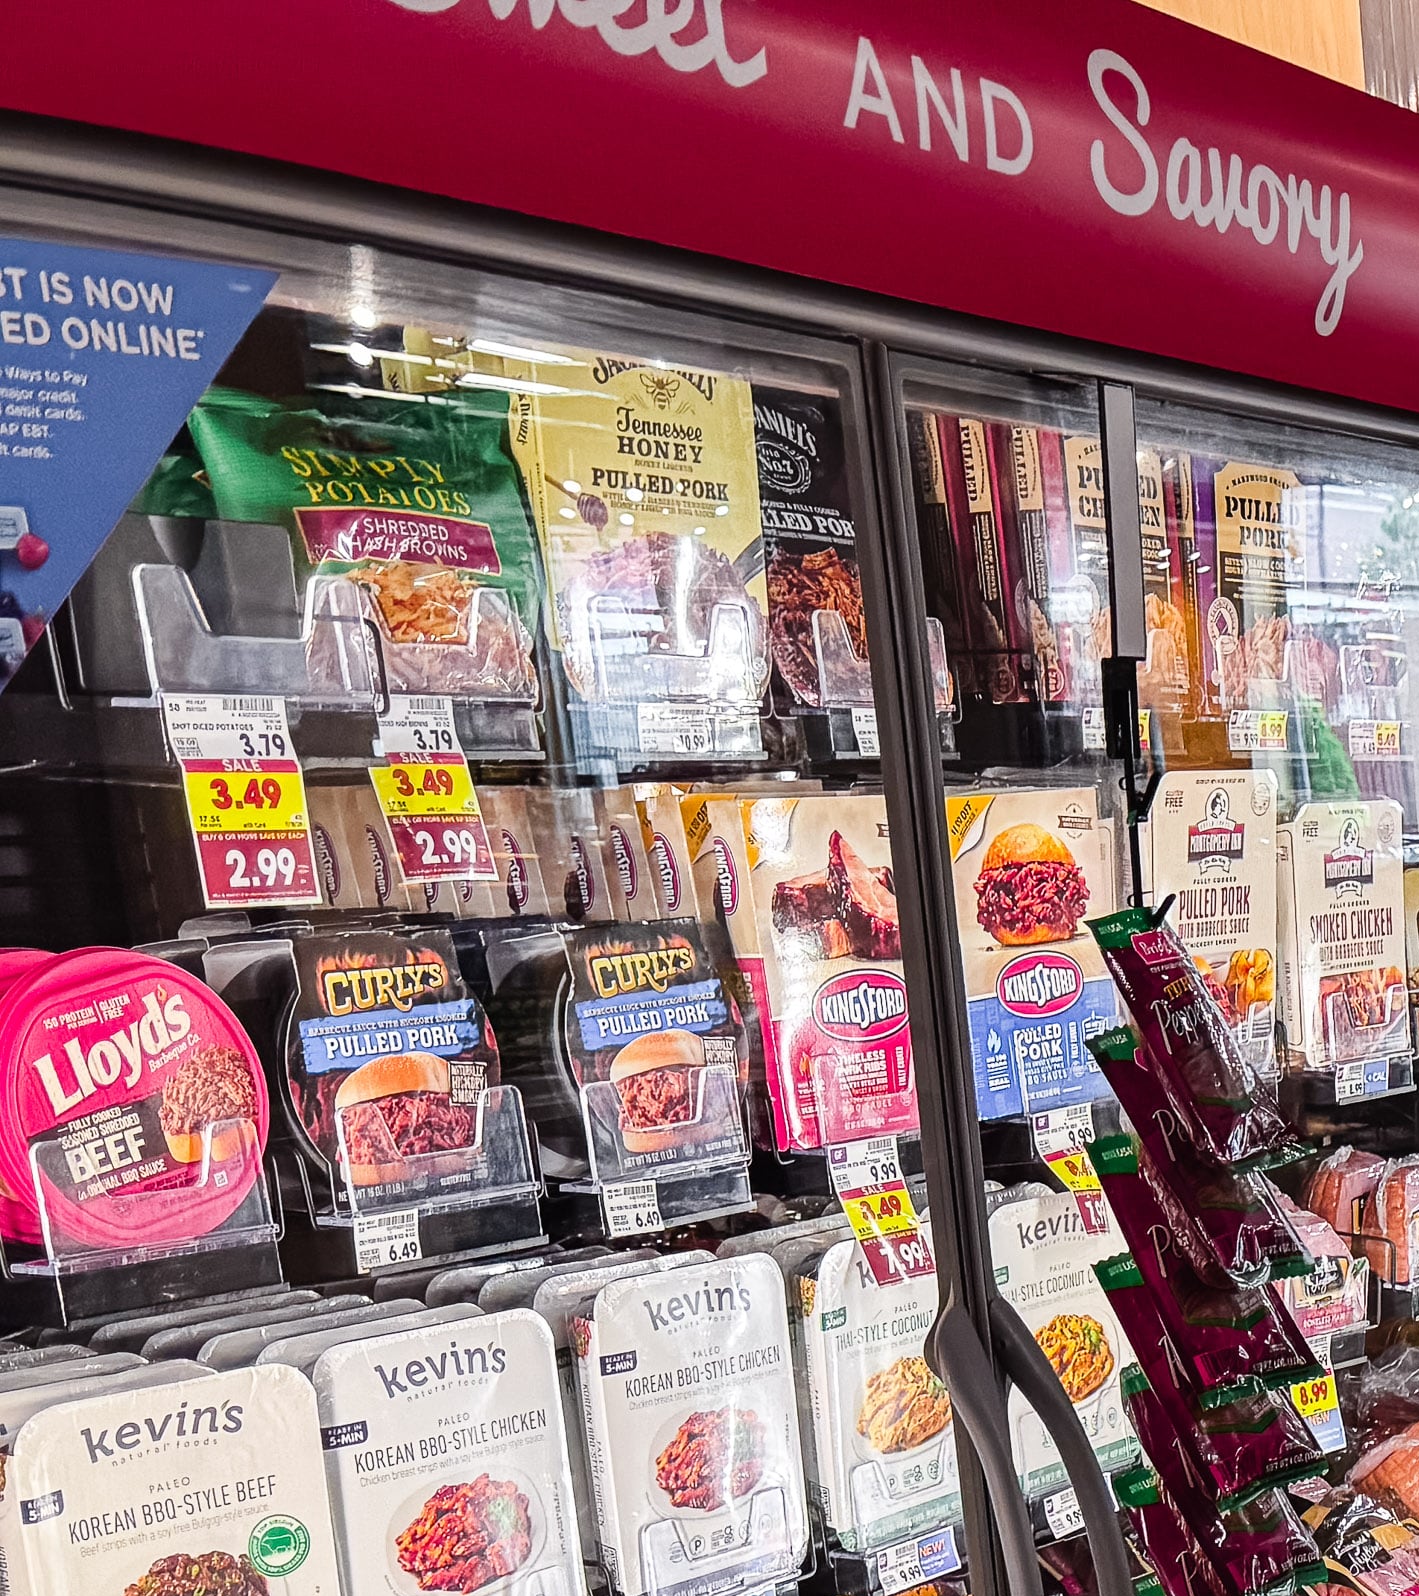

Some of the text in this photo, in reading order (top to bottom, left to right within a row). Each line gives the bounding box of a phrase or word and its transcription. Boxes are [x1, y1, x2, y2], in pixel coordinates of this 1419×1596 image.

[844, 35, 1364, 337] AND Savory
[38, 269, 174, 316] IS NOW
[616, 405, 703, 443] Tennessee
[280, 445, 446, 485] SIMPLY
[616, 434, 704, 464] HONEY
[303, 479, 472, 516] POTATOES
[591, 467, 729, 502] PULLED PORK
[363, 517, 450, 541] SHREDDED
[239, 732, 286, 757] 3.79
[222, 758, 263, 773] SALE
[209, 778, 282, 810] 3.49
[225, 847, 297, 889] 2.99
[1179, 884, 1251, 918] PULLED PORK
[1310, 906, 1394, 944] SMOKED CHICKEN
[324, 963, 444, 1017] CURLY'S
[1004, 962, 1078, 1008] KINGSFORD
[820, 982, 905, 1029] KINGSFORD
[32, 984, 192, 1118] Lloyd's
[324, 1024, 460, 1060] PULLED PORK
[60, 1112, 141, 1151] SEASONED SHREDDED
[68, 1106, 121, 1133] FULLY COOKED
[64, 1126, 146, 1185] BEEF
[388, 1242, 419, 1262] 6.49
[373, 1341, 506, 1400] kevin's
[80, 1397, 244, 1465] kevin's
[176, 1436, 218, 1449] foods
[354, 1445, 415, 1475] KOREAN
[419, 1425, 489, 1459] BBQ-STYLE
[490, 1408, 548, 1439] CHICKEN
[148, 1475, 192, 1494] PALEO
[67, 1508, 136, 1546] KOREAN
[143, 1485, 230, 1525] BBQ-STYLE
[236, 1474, 278, 1502] BEEF
